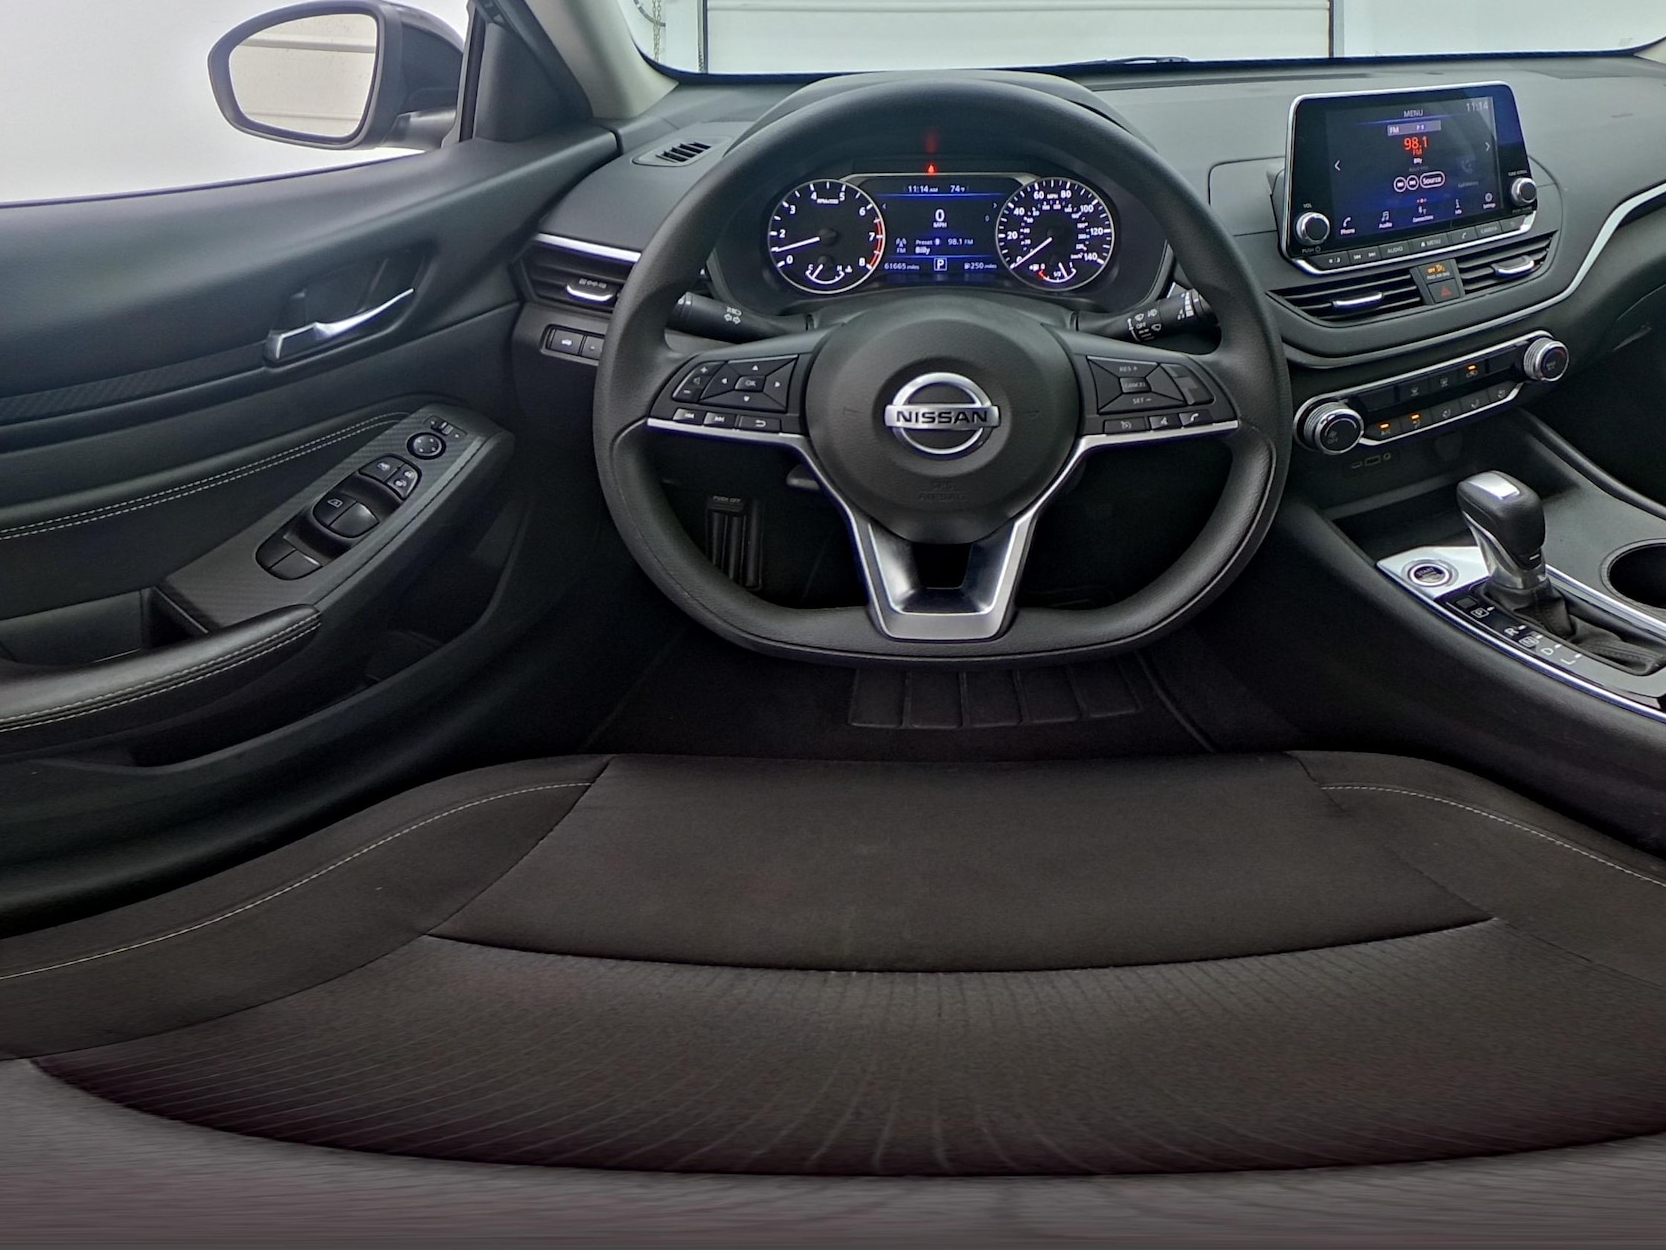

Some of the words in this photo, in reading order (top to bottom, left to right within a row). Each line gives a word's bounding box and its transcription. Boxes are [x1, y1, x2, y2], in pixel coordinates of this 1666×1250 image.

[1466, 101, 1489, 112] 11:14
[1403, 110, 1424, 118] MENU
[1389, 126, 1399, 134] FM
[1404, 136, 1428, 150] 98.1
[1422, 176, 1442, 185] Source
[908, 185, 929, 193] 11:14
[811, 192, 817, 200] 4
[839, 192, 846, 201] 5
[1034, 190, 1044, 200] 60
[1061, 190, 1072, 199] 80
[790, 205, 796, 214] 3
[859, 207, 866, 216] 6
[1013, 207, 1025, 216] 40
[1080, 204, 1094, 213] 100
[935, 209, 945, 222] 0
[779, 229, 786, 238] 2
[1006, 231, 1018, 240] 20
[1090, 227, 1103, 236] 120
[869, 232, 875, 241] 7
[1387, 246, 1403, 254] AUDIO
[786, 255, 793, 264] 0
[1084, 252, 1098, 261] 140
[859, 257, 866, 266] 8
[896, 410, 988, 424] NISSAN
[1504, 626, 1519, 637] R
[1540, 647, 1555, 656] D
[1560, 657, 1577, 666] L
